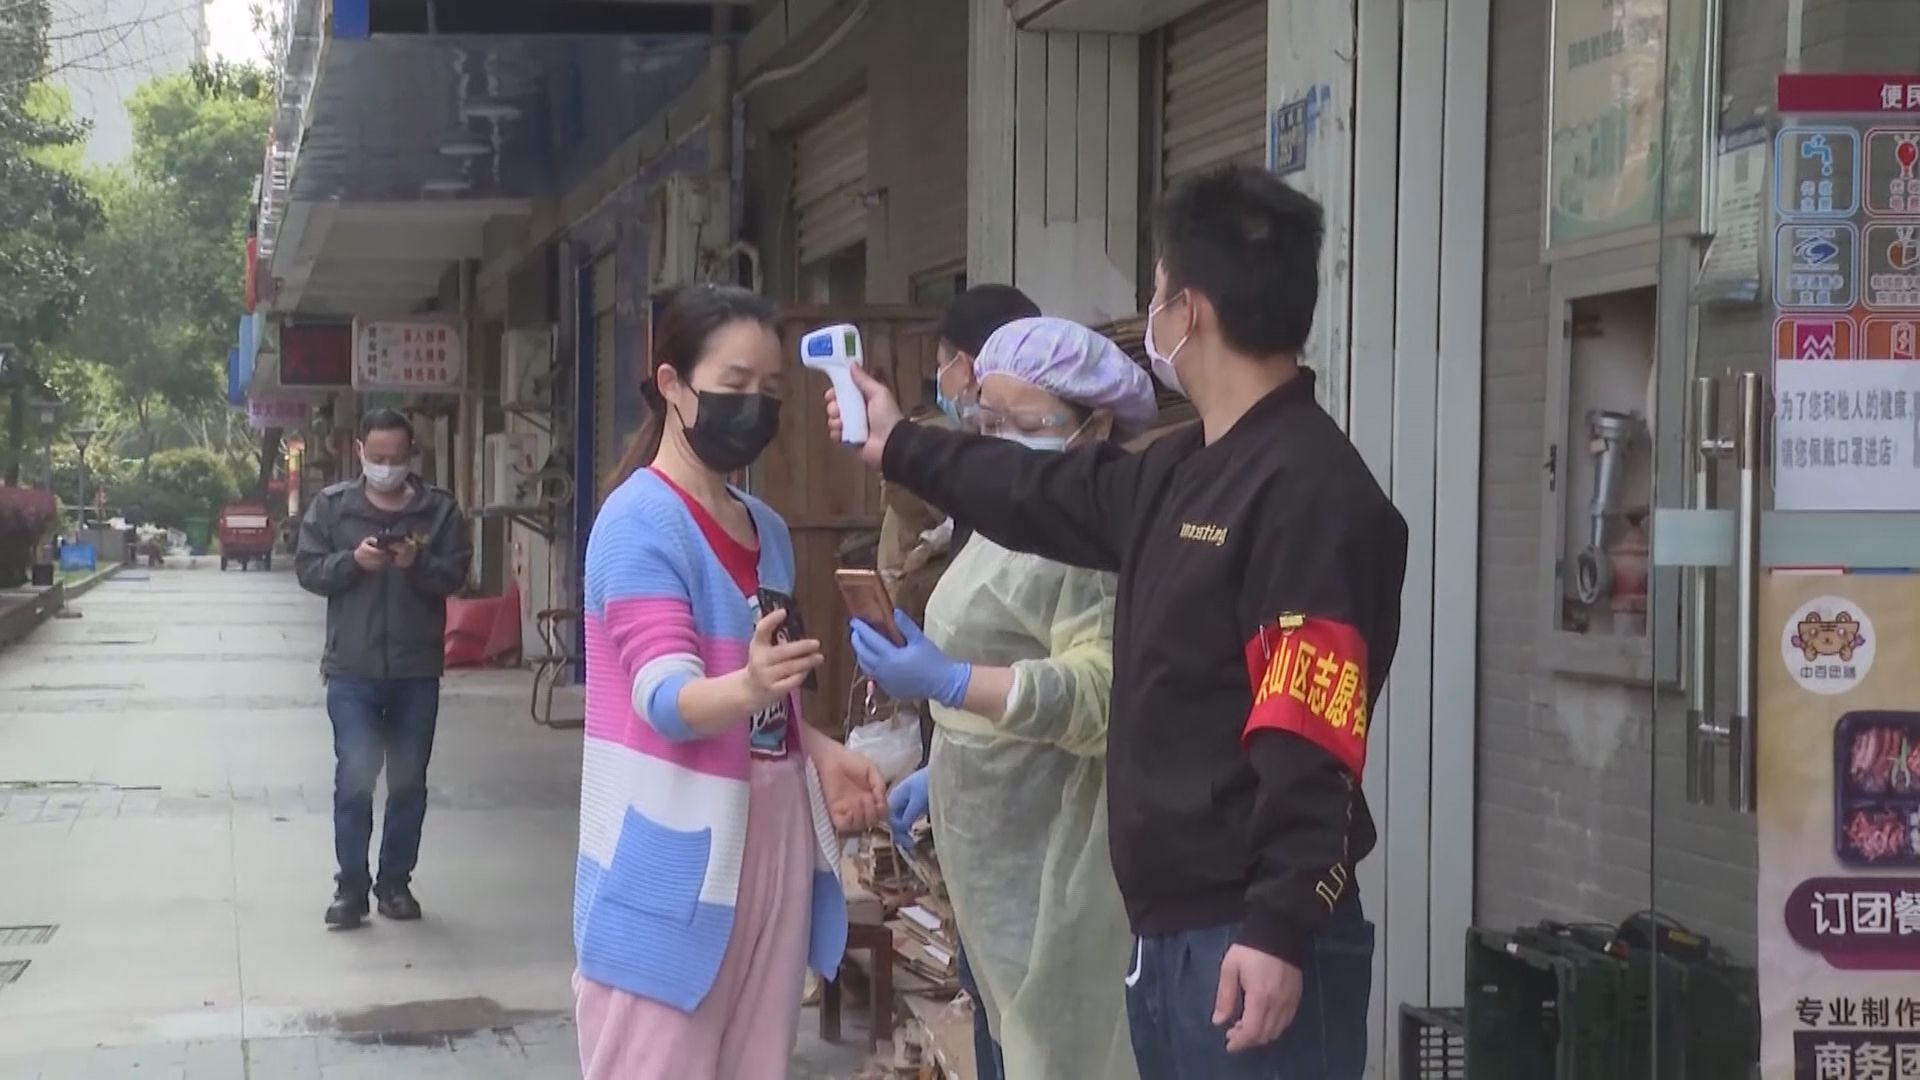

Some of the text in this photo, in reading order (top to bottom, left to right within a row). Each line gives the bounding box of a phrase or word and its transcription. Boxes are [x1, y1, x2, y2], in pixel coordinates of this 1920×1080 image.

[1811, 890, 1920, 935] 订团餐
[1795, 997, 1920, 1028] 专业制作
